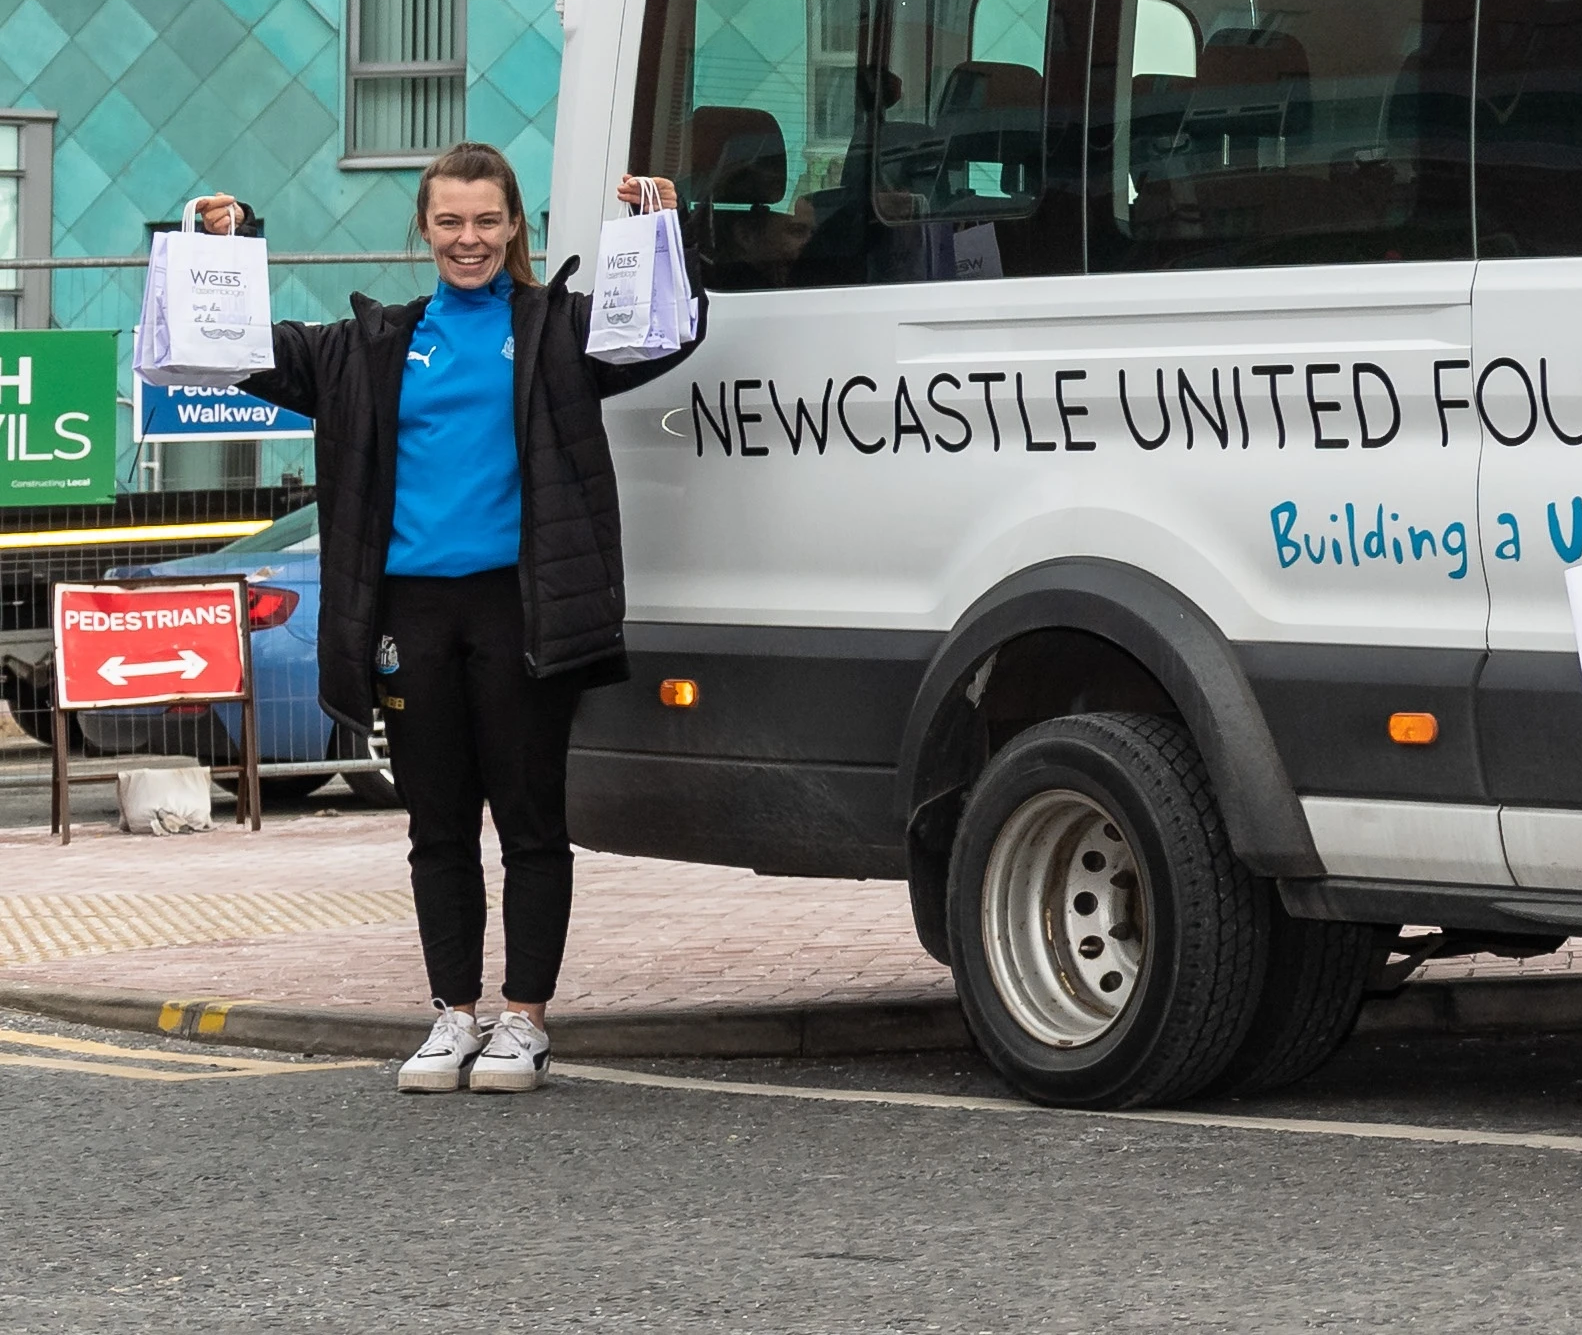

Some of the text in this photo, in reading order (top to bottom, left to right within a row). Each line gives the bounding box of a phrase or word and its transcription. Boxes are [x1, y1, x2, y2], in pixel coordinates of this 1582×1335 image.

[177, 402, 279, 427] Walkway
[691, 370, 1096, 457] NEWCASTLE
[1118, 362, 1403, 452] UNITED
[0, 411, 92, 462] ILS
[1270, 498, 1468, 579] Building
[1494, 512, 1521, 561] a
[65, 605, 232, 632] PEDESTRIANS
